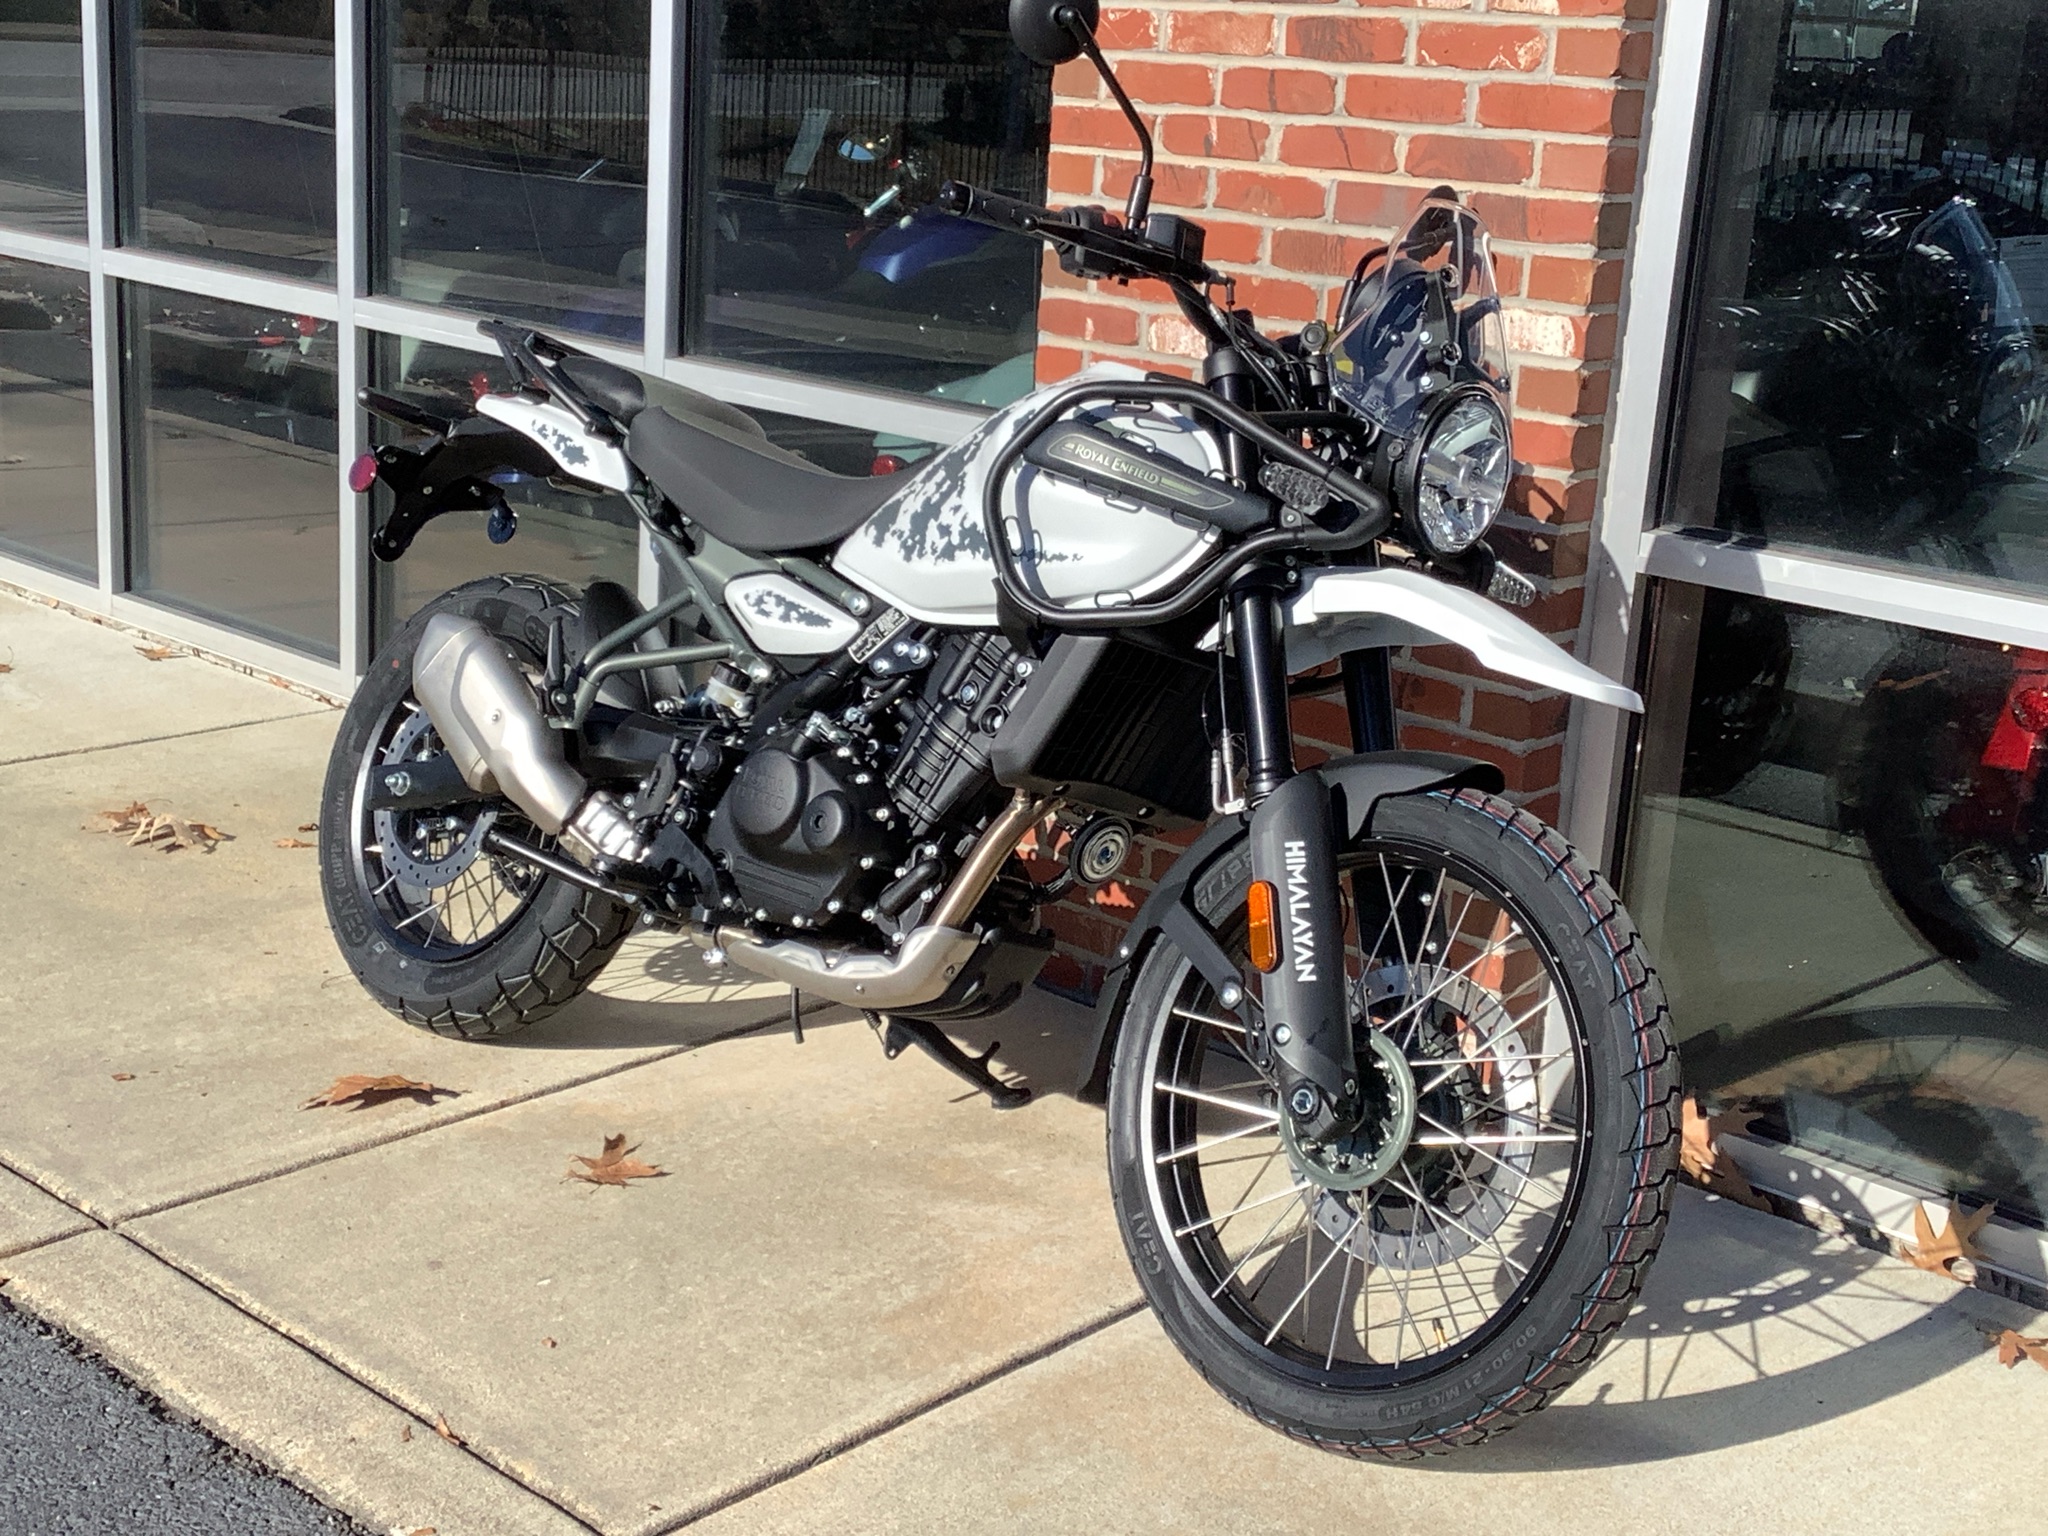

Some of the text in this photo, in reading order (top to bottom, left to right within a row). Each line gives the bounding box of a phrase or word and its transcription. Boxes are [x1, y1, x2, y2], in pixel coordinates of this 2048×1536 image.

[1075, 443, 1158, 484] ROYAL ENFIELD
[1284, 841, 1317, 982] HIMALAYAN
[1127, 1211, 1162, 1275] CEAT
